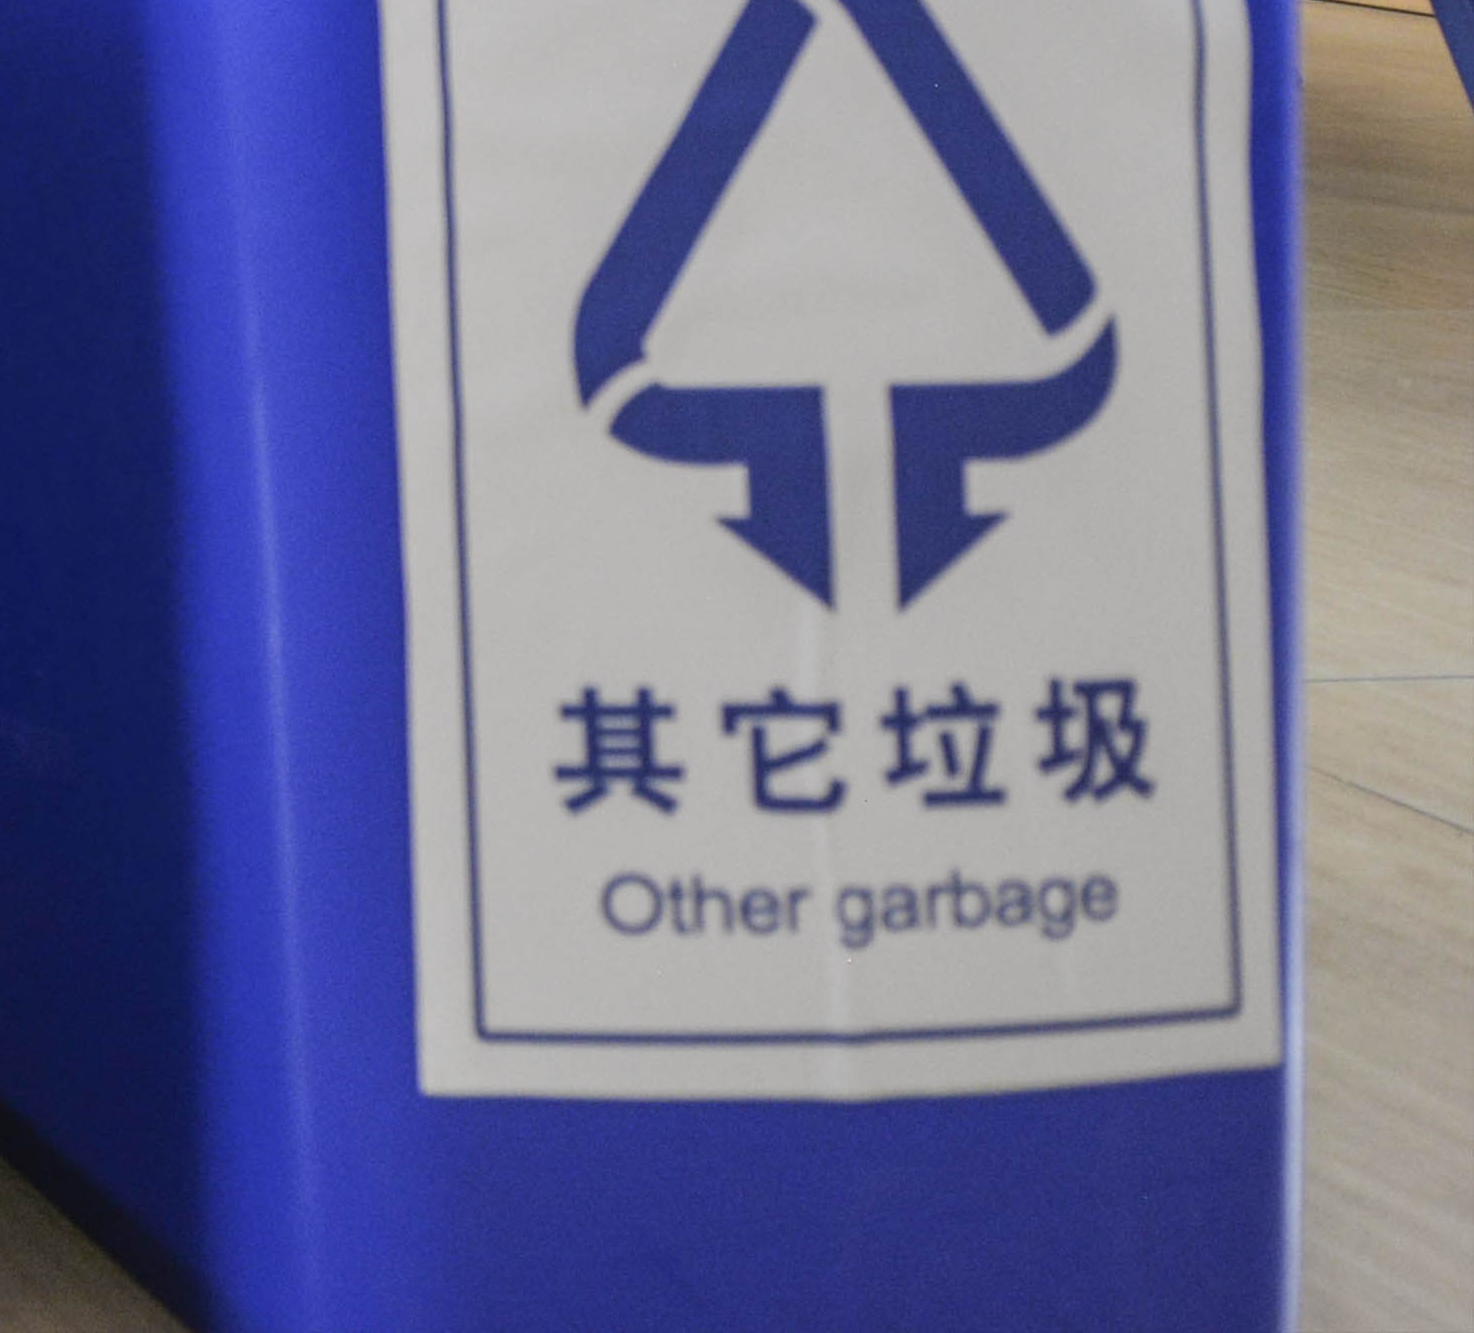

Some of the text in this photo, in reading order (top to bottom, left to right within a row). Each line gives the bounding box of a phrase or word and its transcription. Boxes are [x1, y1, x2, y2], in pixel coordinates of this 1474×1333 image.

[553, 676, 1156, 816] 其它垃圾
[600, 869, 1119, 950] Other garbage
